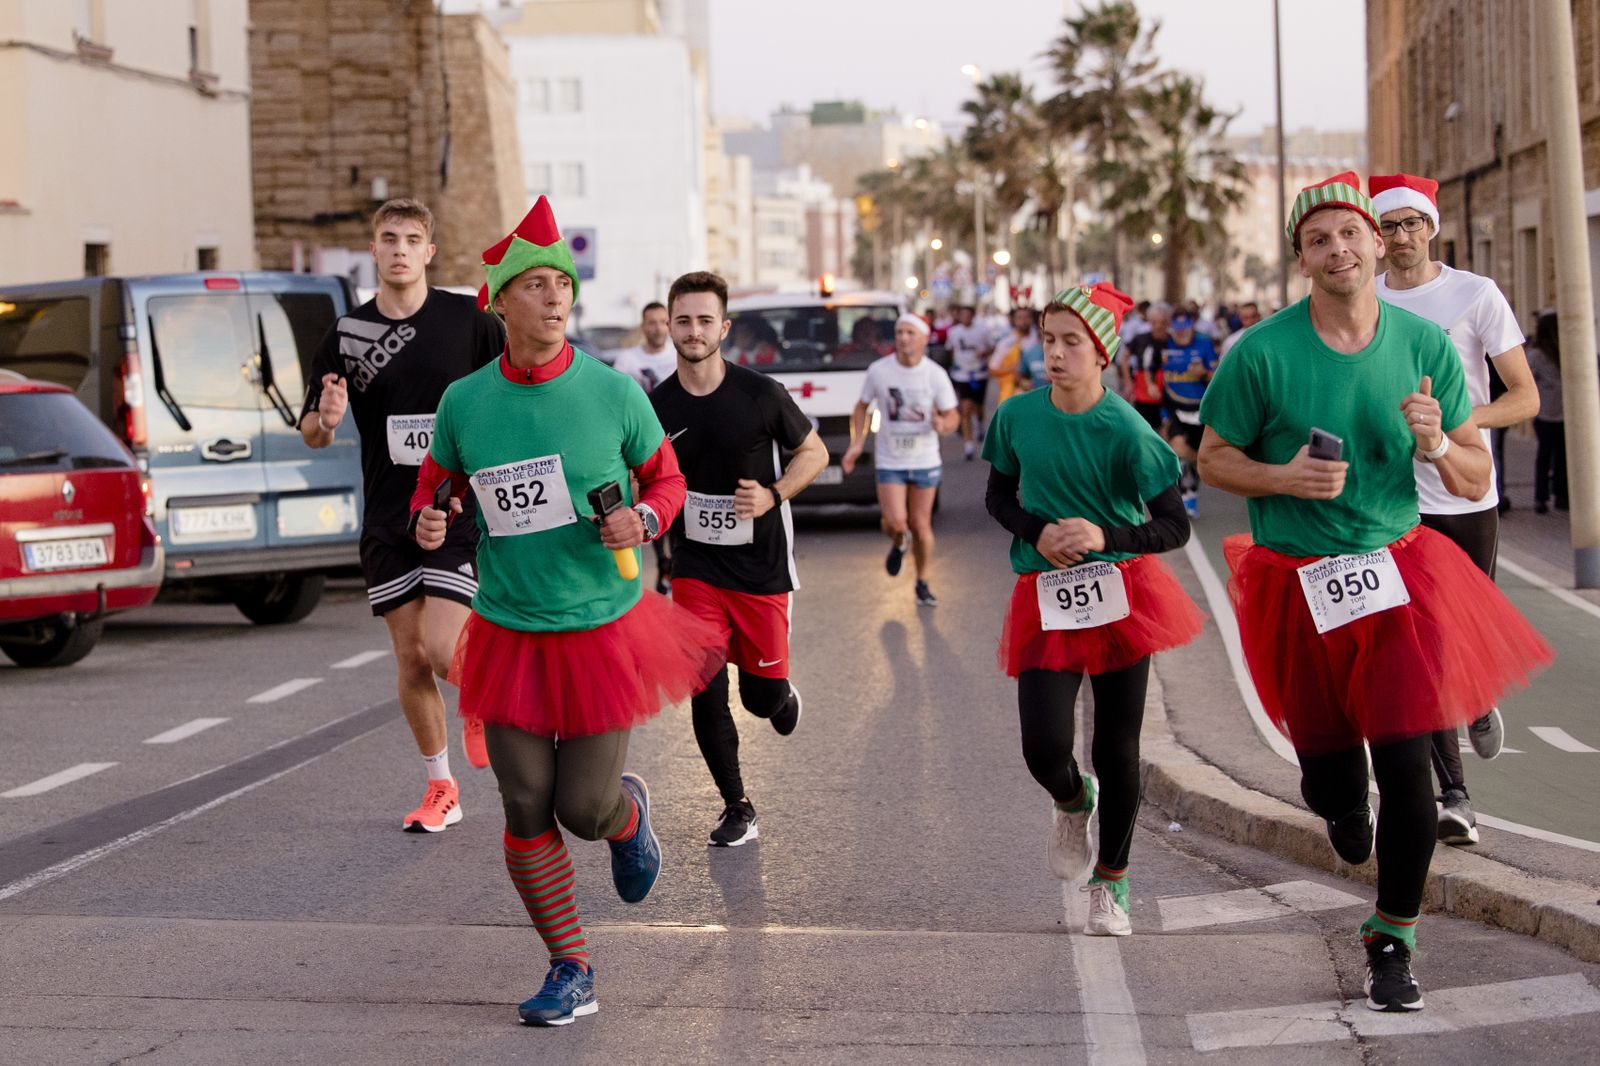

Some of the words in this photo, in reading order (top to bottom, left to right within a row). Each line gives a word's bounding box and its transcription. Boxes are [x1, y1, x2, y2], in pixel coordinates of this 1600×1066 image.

[353, 323, 416, 392] adidas
[404, 431, 434, 450] 40
[475, 471, 495, 480] SAN
[496, 459, 554, 476] SILVESTRE
[478, 475, 511, 486] CIUDAD
[513, 472, 527, 481] DE
[494, 480, 549, 512] 852
[698, 510, 737, 530] 555
[36, 543, 73, 564] 3783
[1306, 564, 1327, 577] SAN
[1328, 551, 1384, 567] SILVESTRE
[1060, 563, 1112, 576] SILVESTRE
[1308, 567, 1343, 584] CIUDAD
[1344, 562, 1358, 570] DE
[1042, 577, 1074, 588] CIUDAD
[1075, 574, 1087, 582] DE
[1326, 568, 1380, 604] 950
[1056, 580, 1103, 610] 951
[1350, 595, 1366, 604] TONI
